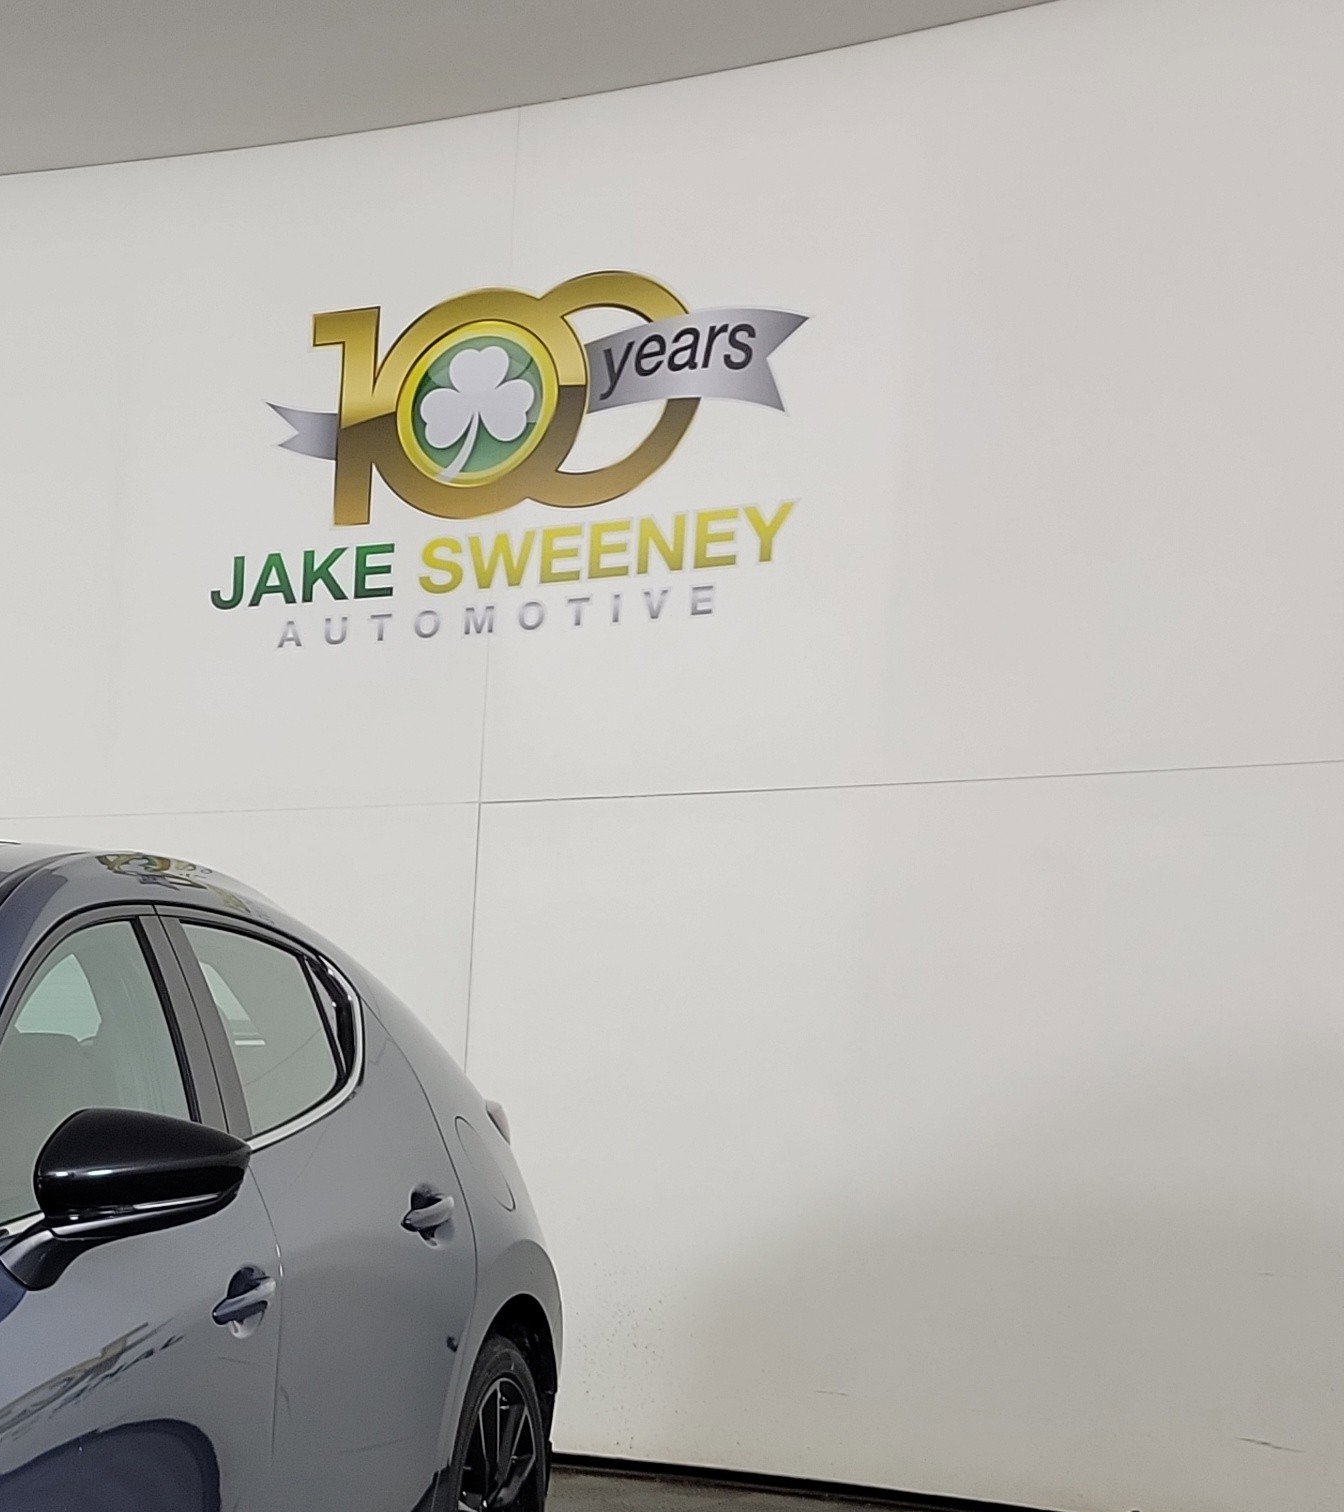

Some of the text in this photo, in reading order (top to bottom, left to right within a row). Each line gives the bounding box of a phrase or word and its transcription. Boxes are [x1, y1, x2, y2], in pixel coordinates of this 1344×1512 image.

[312, 270, 757, 527] 100 years
[210, 501, 797, 610] JAKE SWEENEY
[277, 585, 714, 649] AUTOMOTIVE
